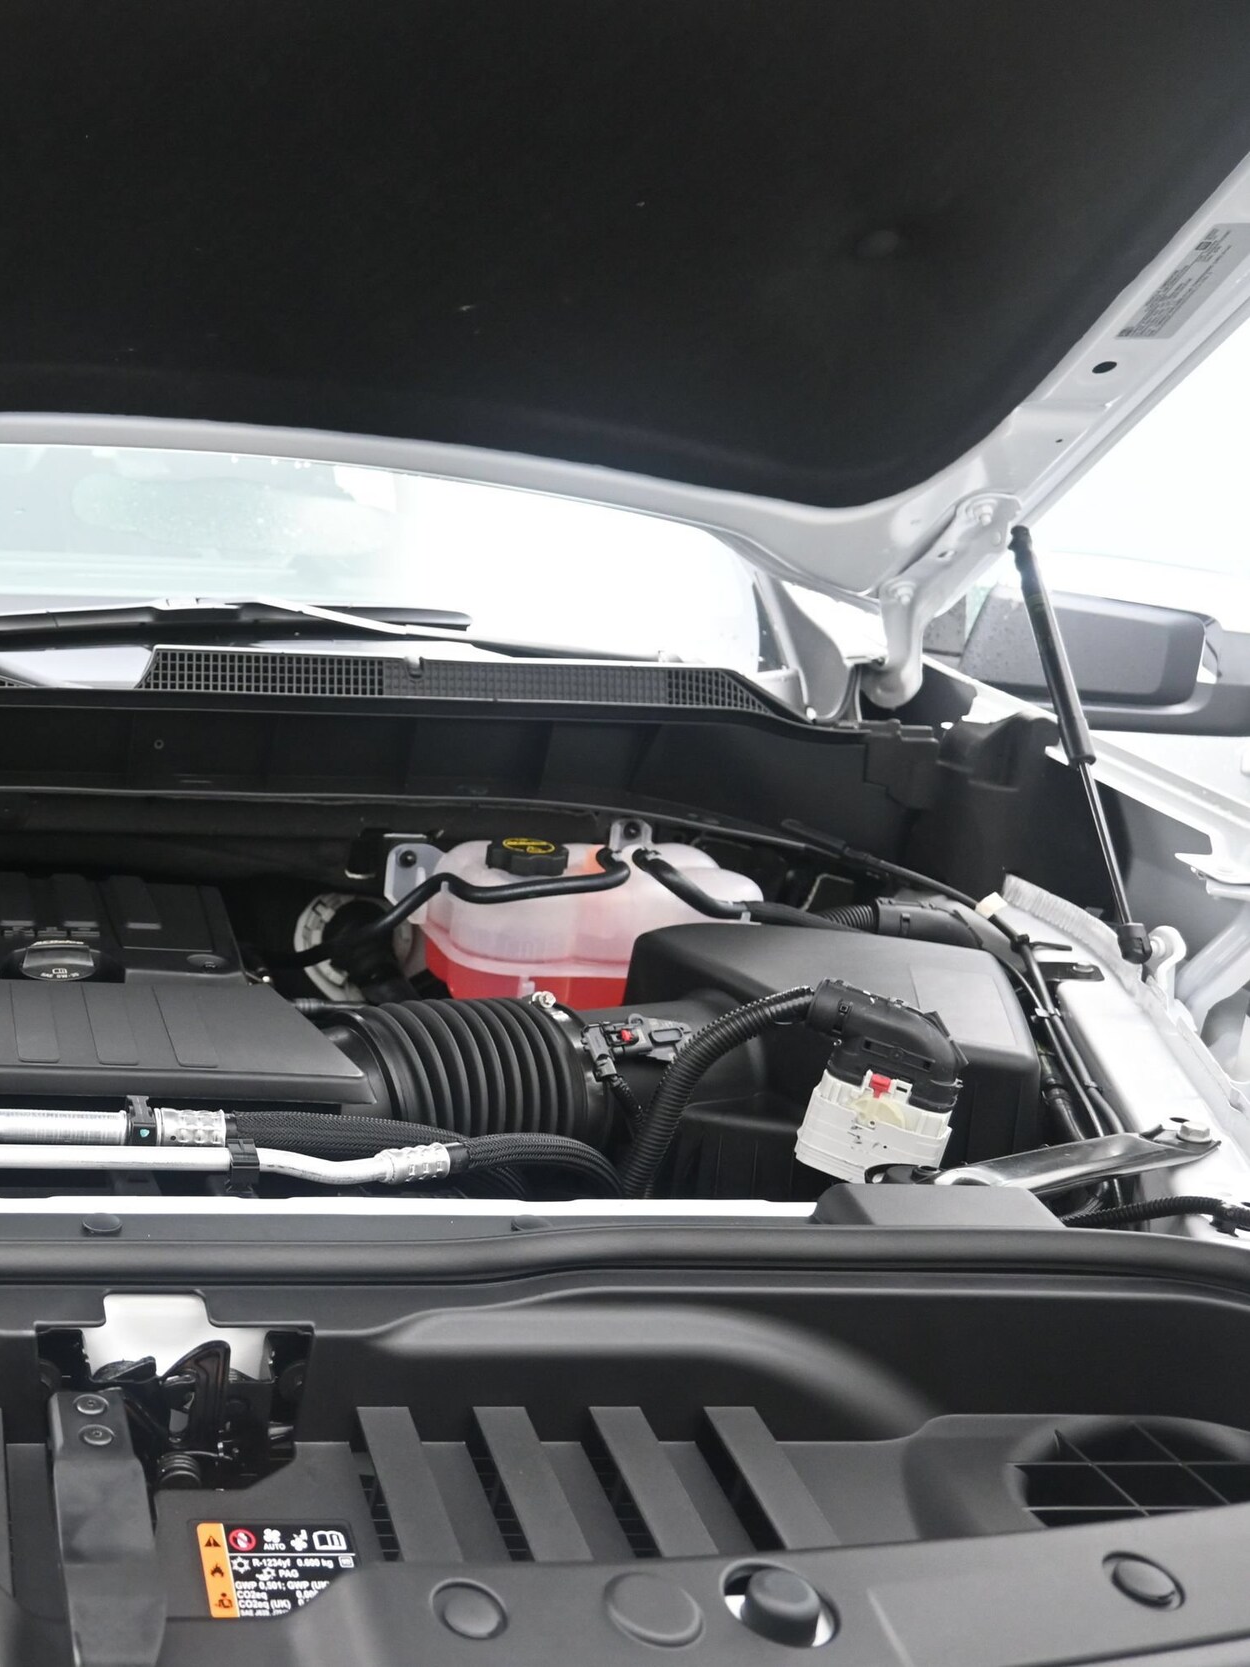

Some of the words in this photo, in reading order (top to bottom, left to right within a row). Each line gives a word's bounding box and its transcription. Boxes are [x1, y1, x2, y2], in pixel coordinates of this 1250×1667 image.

[252, 1558, 291, 1568] R-1234yf
[321, 1558, 334, 1569] kg
[278, 1569, 299, 1578] PAG
[235, 1581, 257, 1590] GWP
[286, 1581, 310, 1590] GWP
[311, 1581, 330, 1591] (UK
[236, 1590, 268, 1600] CO2eq
[238, 1599, 270, 1610] CO2eq
[270, 1599, 291, 1610] (UK)
